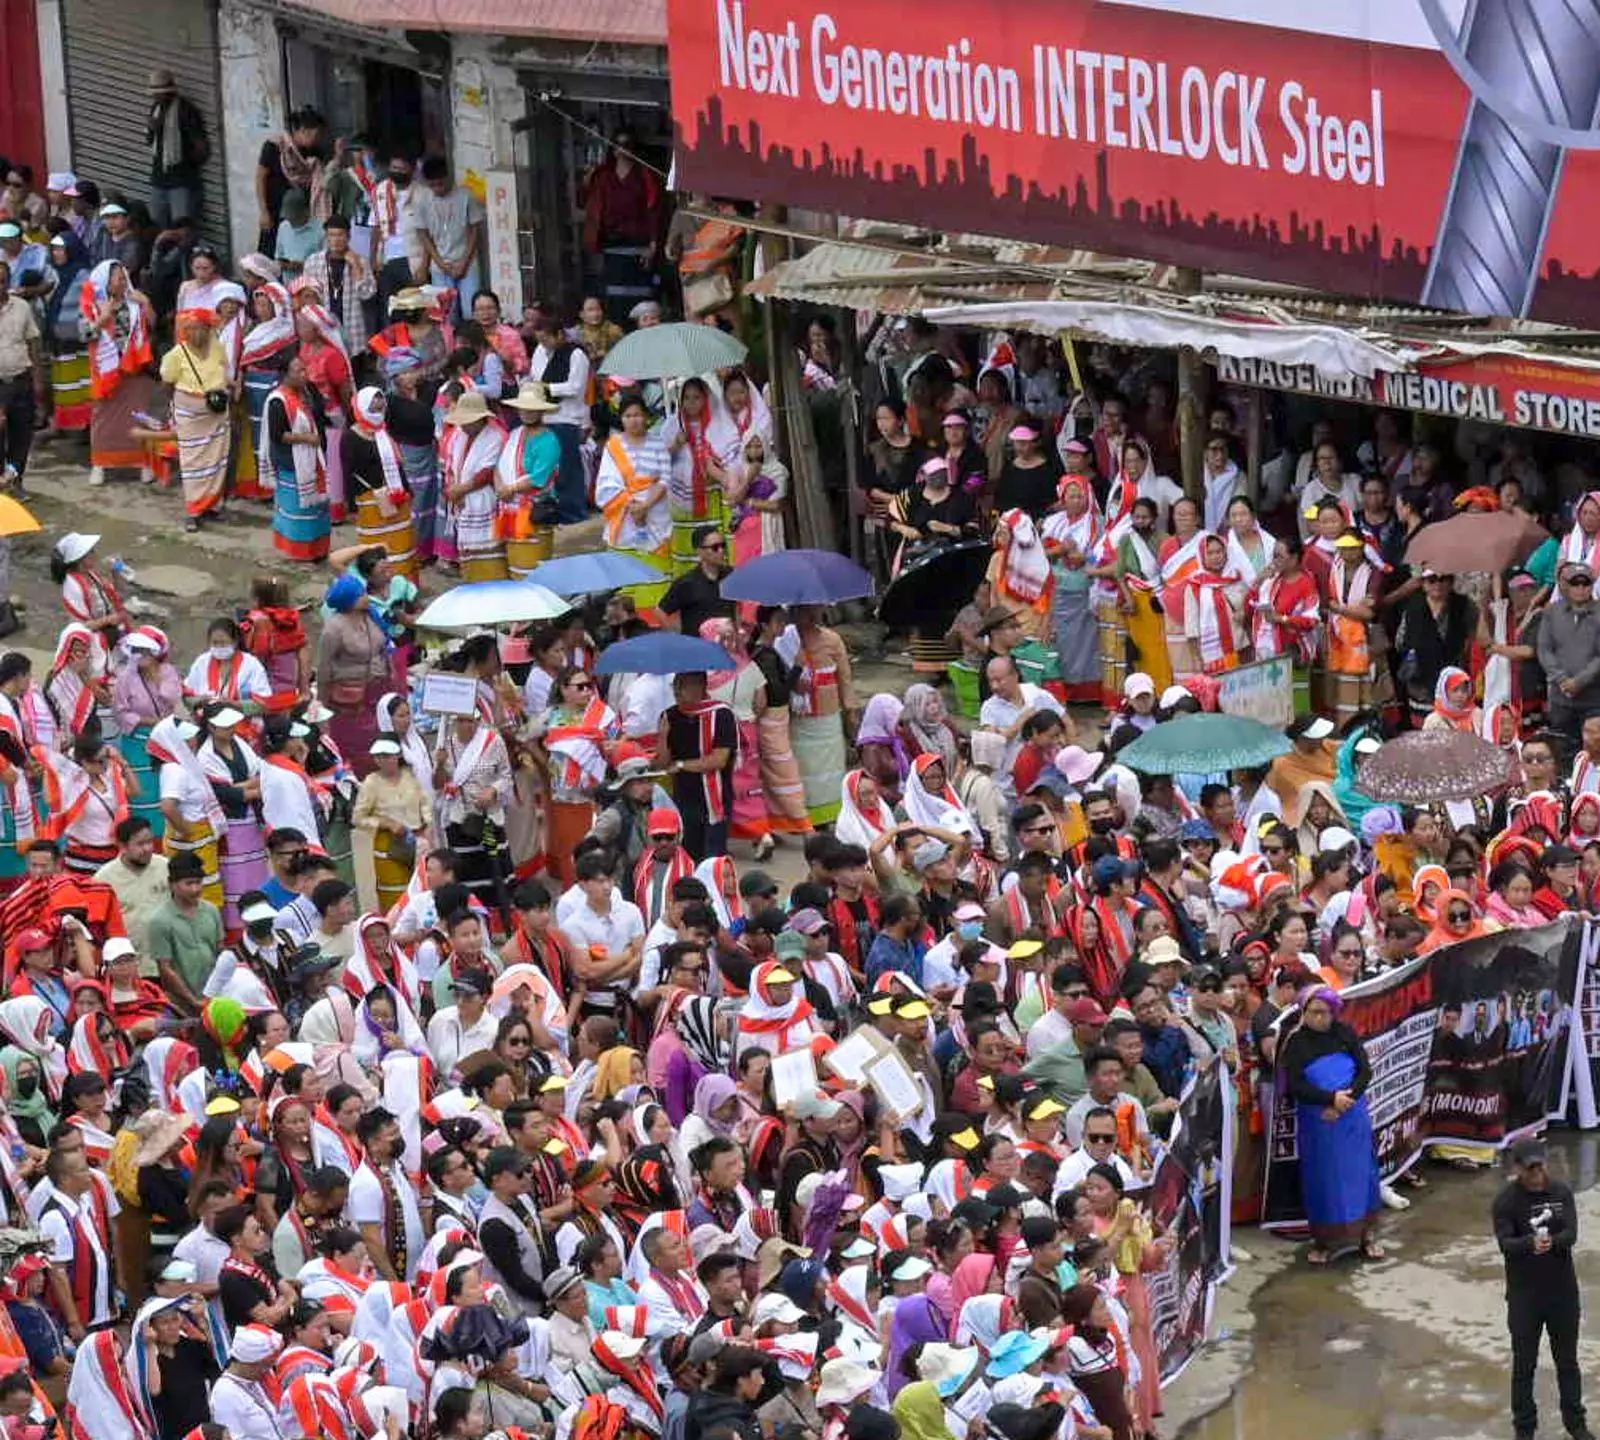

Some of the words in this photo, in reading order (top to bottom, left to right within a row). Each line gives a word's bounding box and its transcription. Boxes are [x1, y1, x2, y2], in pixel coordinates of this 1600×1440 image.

[717, 0, 801, 98] Next
[810, 13, 1021, 132] Generation
[1033, 44, 1269, 169] INTERLOCK
[1279, 79, 1385, 187] Steel
[1383, 372, 1503, 421] MEDICAL
